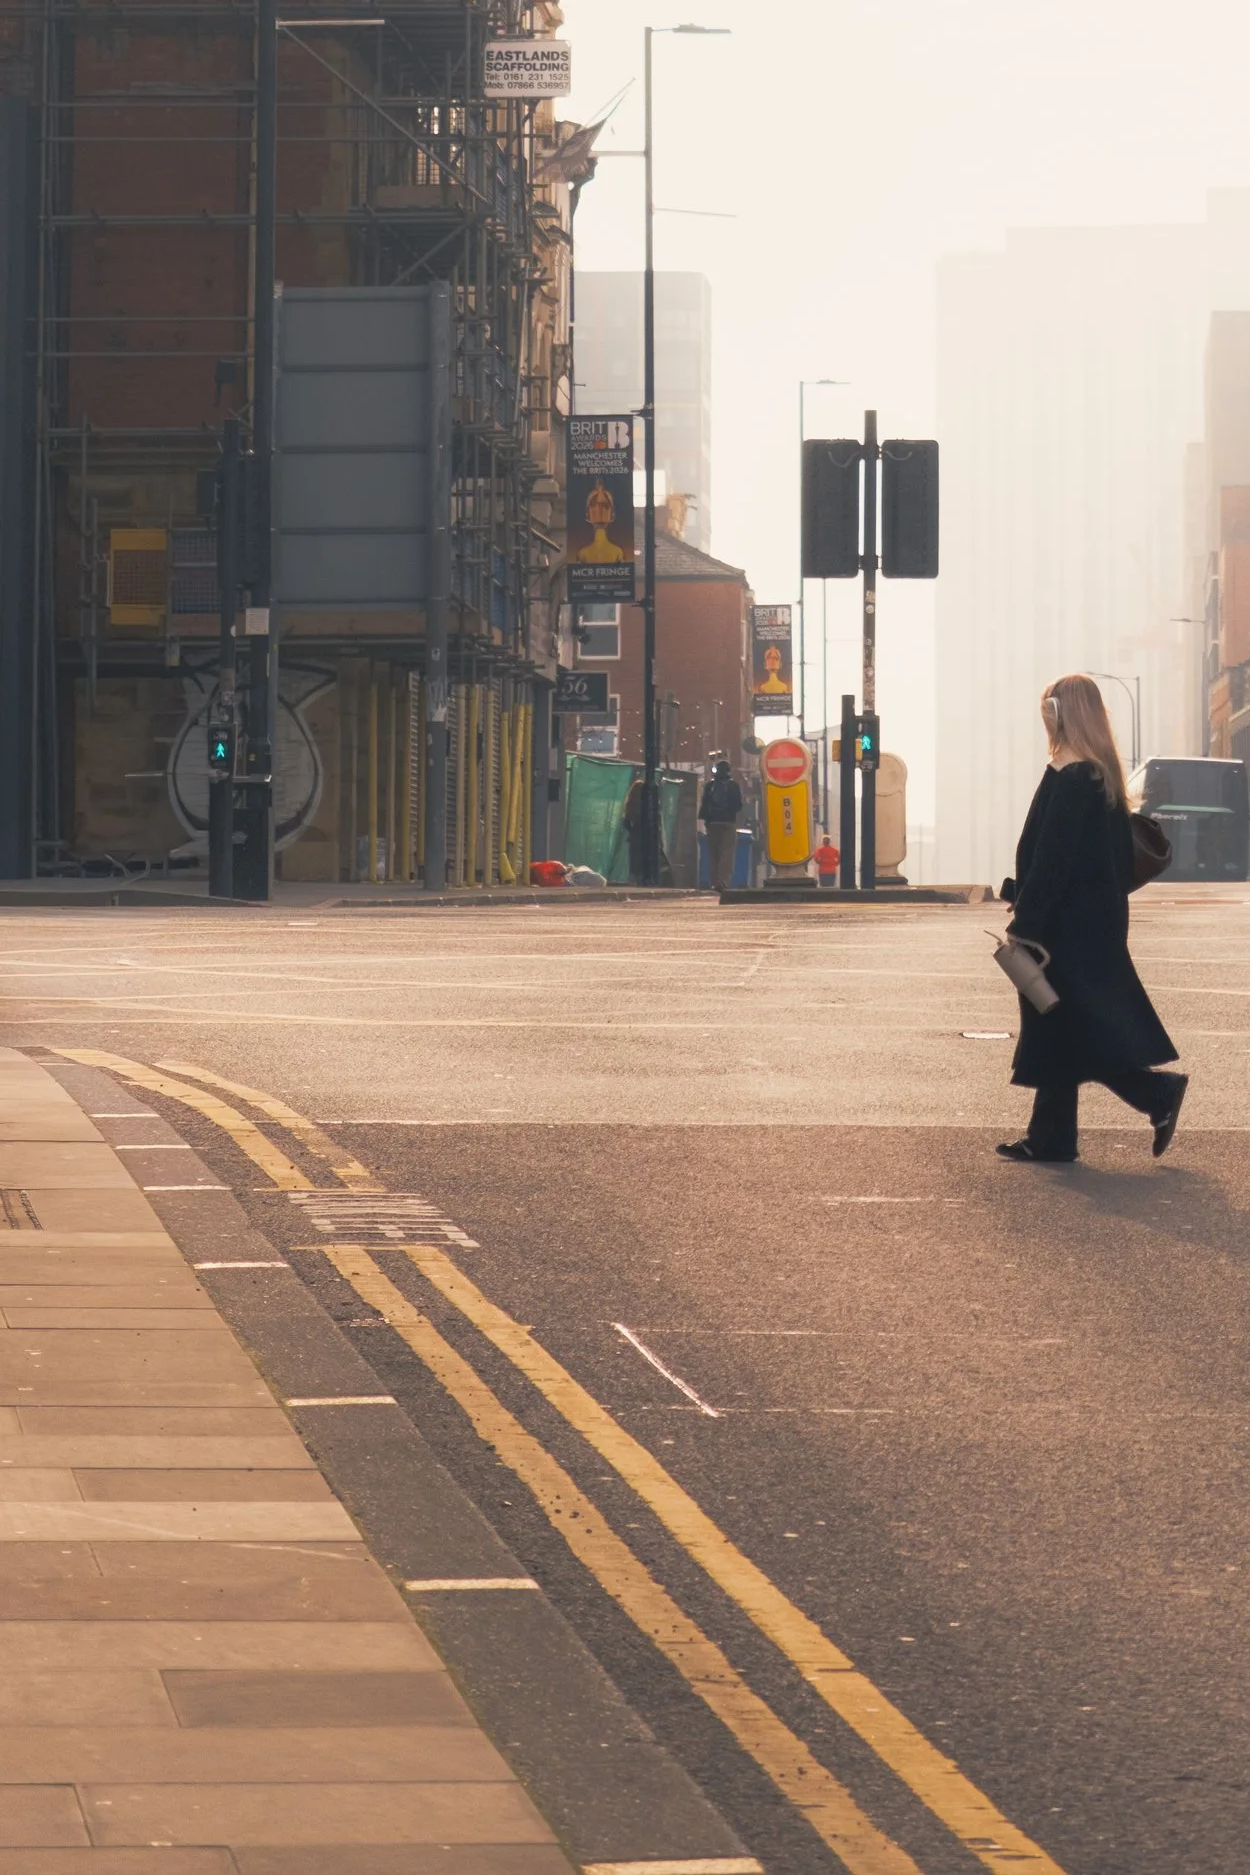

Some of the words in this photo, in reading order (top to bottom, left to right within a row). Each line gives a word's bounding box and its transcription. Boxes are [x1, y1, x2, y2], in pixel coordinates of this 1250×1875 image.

[486, 51, 569, 61] EASTLANDS
[486, 63, 569, 71] SCAFFOLDING
[504, 73, 524, 81] 0161
[528, 73, 543, 81] 231
[549, 73, 569, 81] 1525
[508, 82, 534, 90] 07866
[570, 421, 606, 435] BRIT
[571, 441, 594, 450] 2026
[574, 452, 627, 460] MANCHESTER
[572, 467, 588, 475] THE
[571, 568, 594, 577] MCR
[595, 567, 630, 576] FRINGE
[754, 608, 777, 616] BRIT
